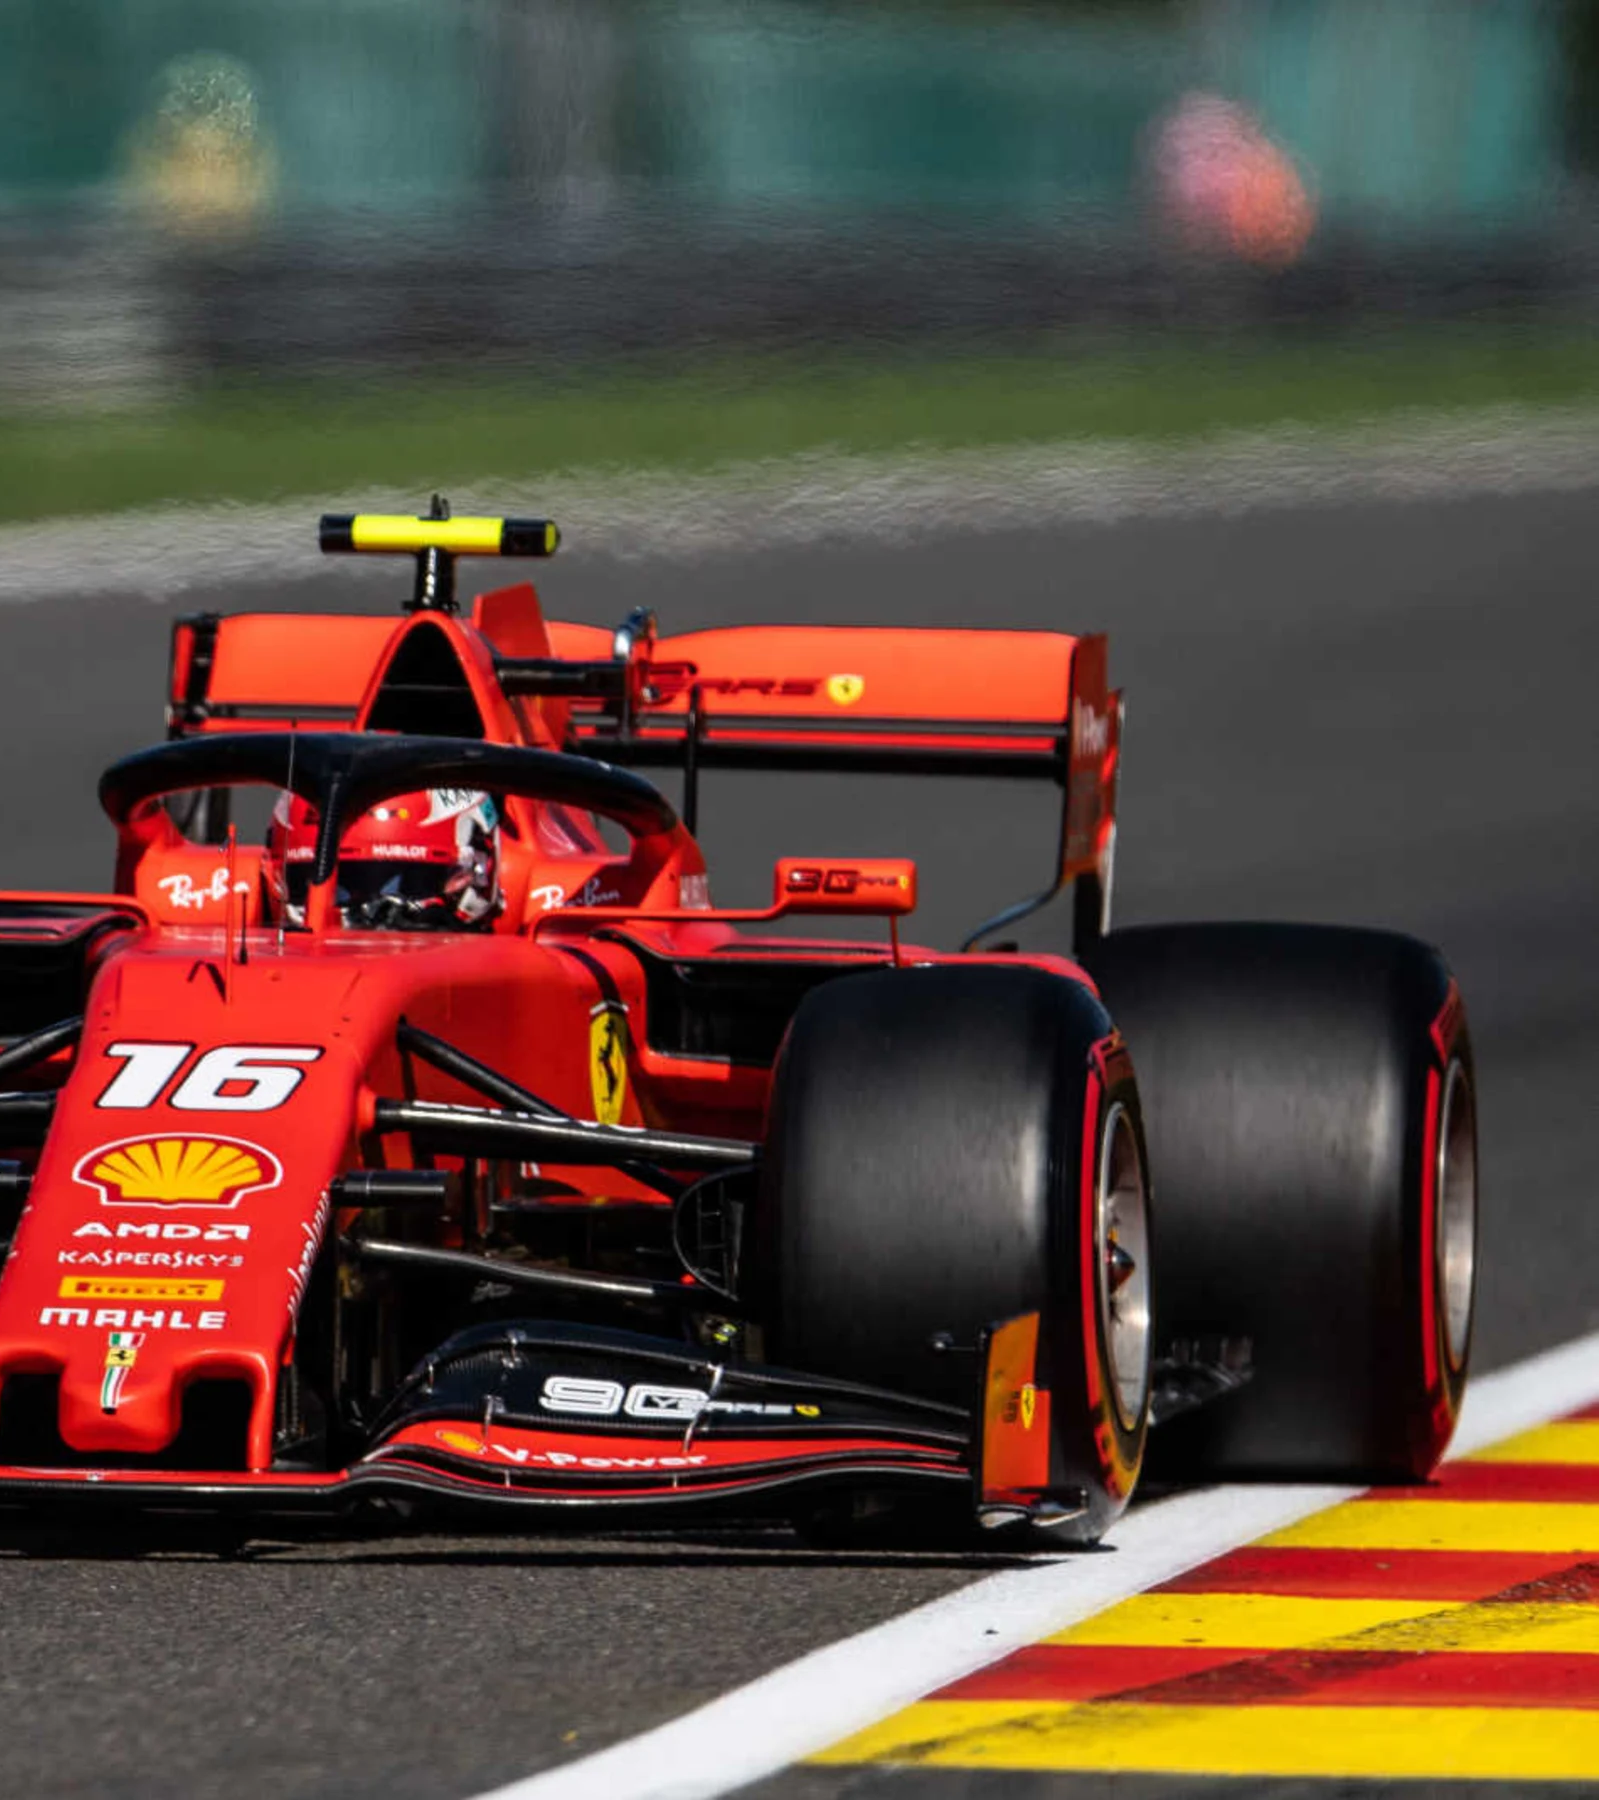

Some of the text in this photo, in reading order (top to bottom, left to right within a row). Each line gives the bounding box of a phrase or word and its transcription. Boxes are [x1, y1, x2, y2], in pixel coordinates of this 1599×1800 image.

[372, 844, 428, 860] HUBLOT
[94, 1039, 326, 1113] 16
[72, 1222, 202, 1240] AMD
[57, 1250, 229, 1268] KASPERSKY
[38, 1307, 228, 1330] MAHLE
[538, 1376, 710, 1419] 90
[490, 1443, 709, 1468] V-Power
